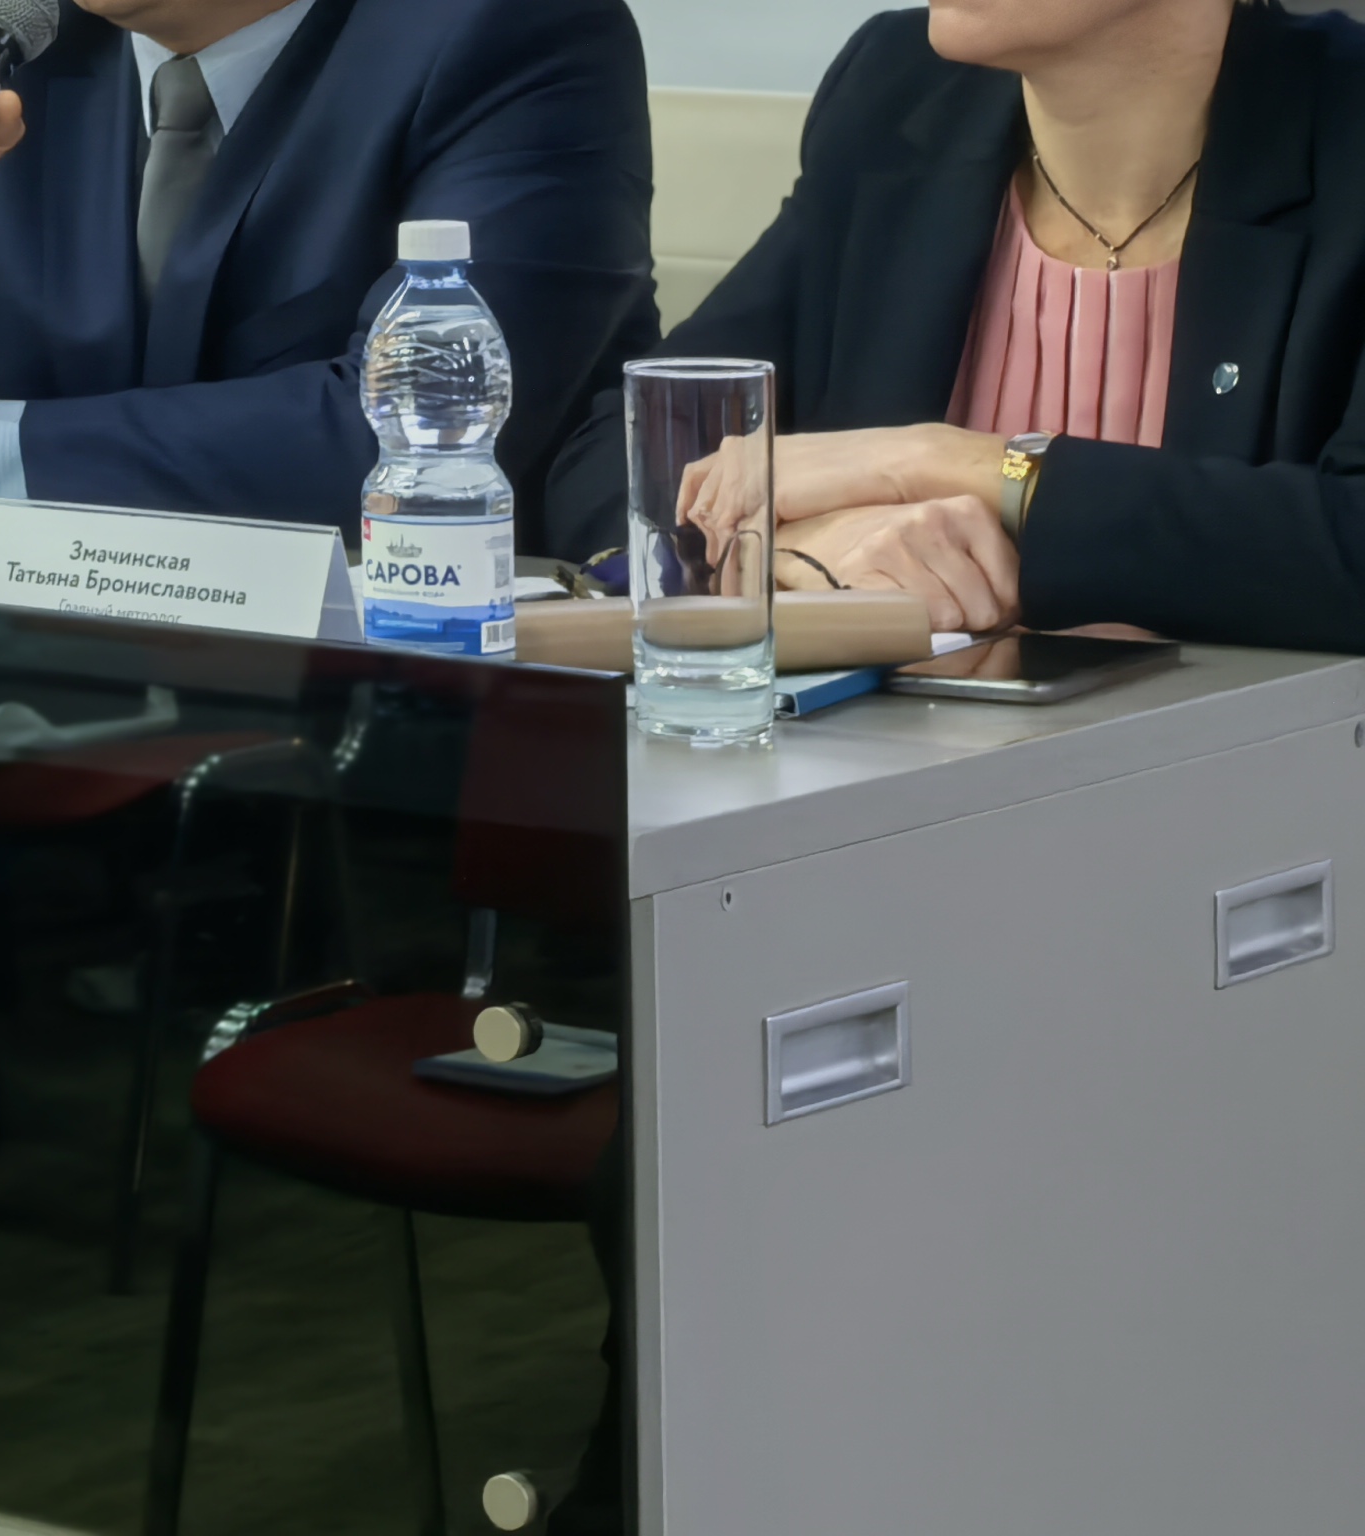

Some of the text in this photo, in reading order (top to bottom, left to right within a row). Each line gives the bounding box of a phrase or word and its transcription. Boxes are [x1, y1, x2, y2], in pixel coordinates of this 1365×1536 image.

[68, 539, 191, 572] Змачинская
[6, 561, 248, 606] Татьяна Брониславовна
[366, 558, 461, 587] САРОВА
